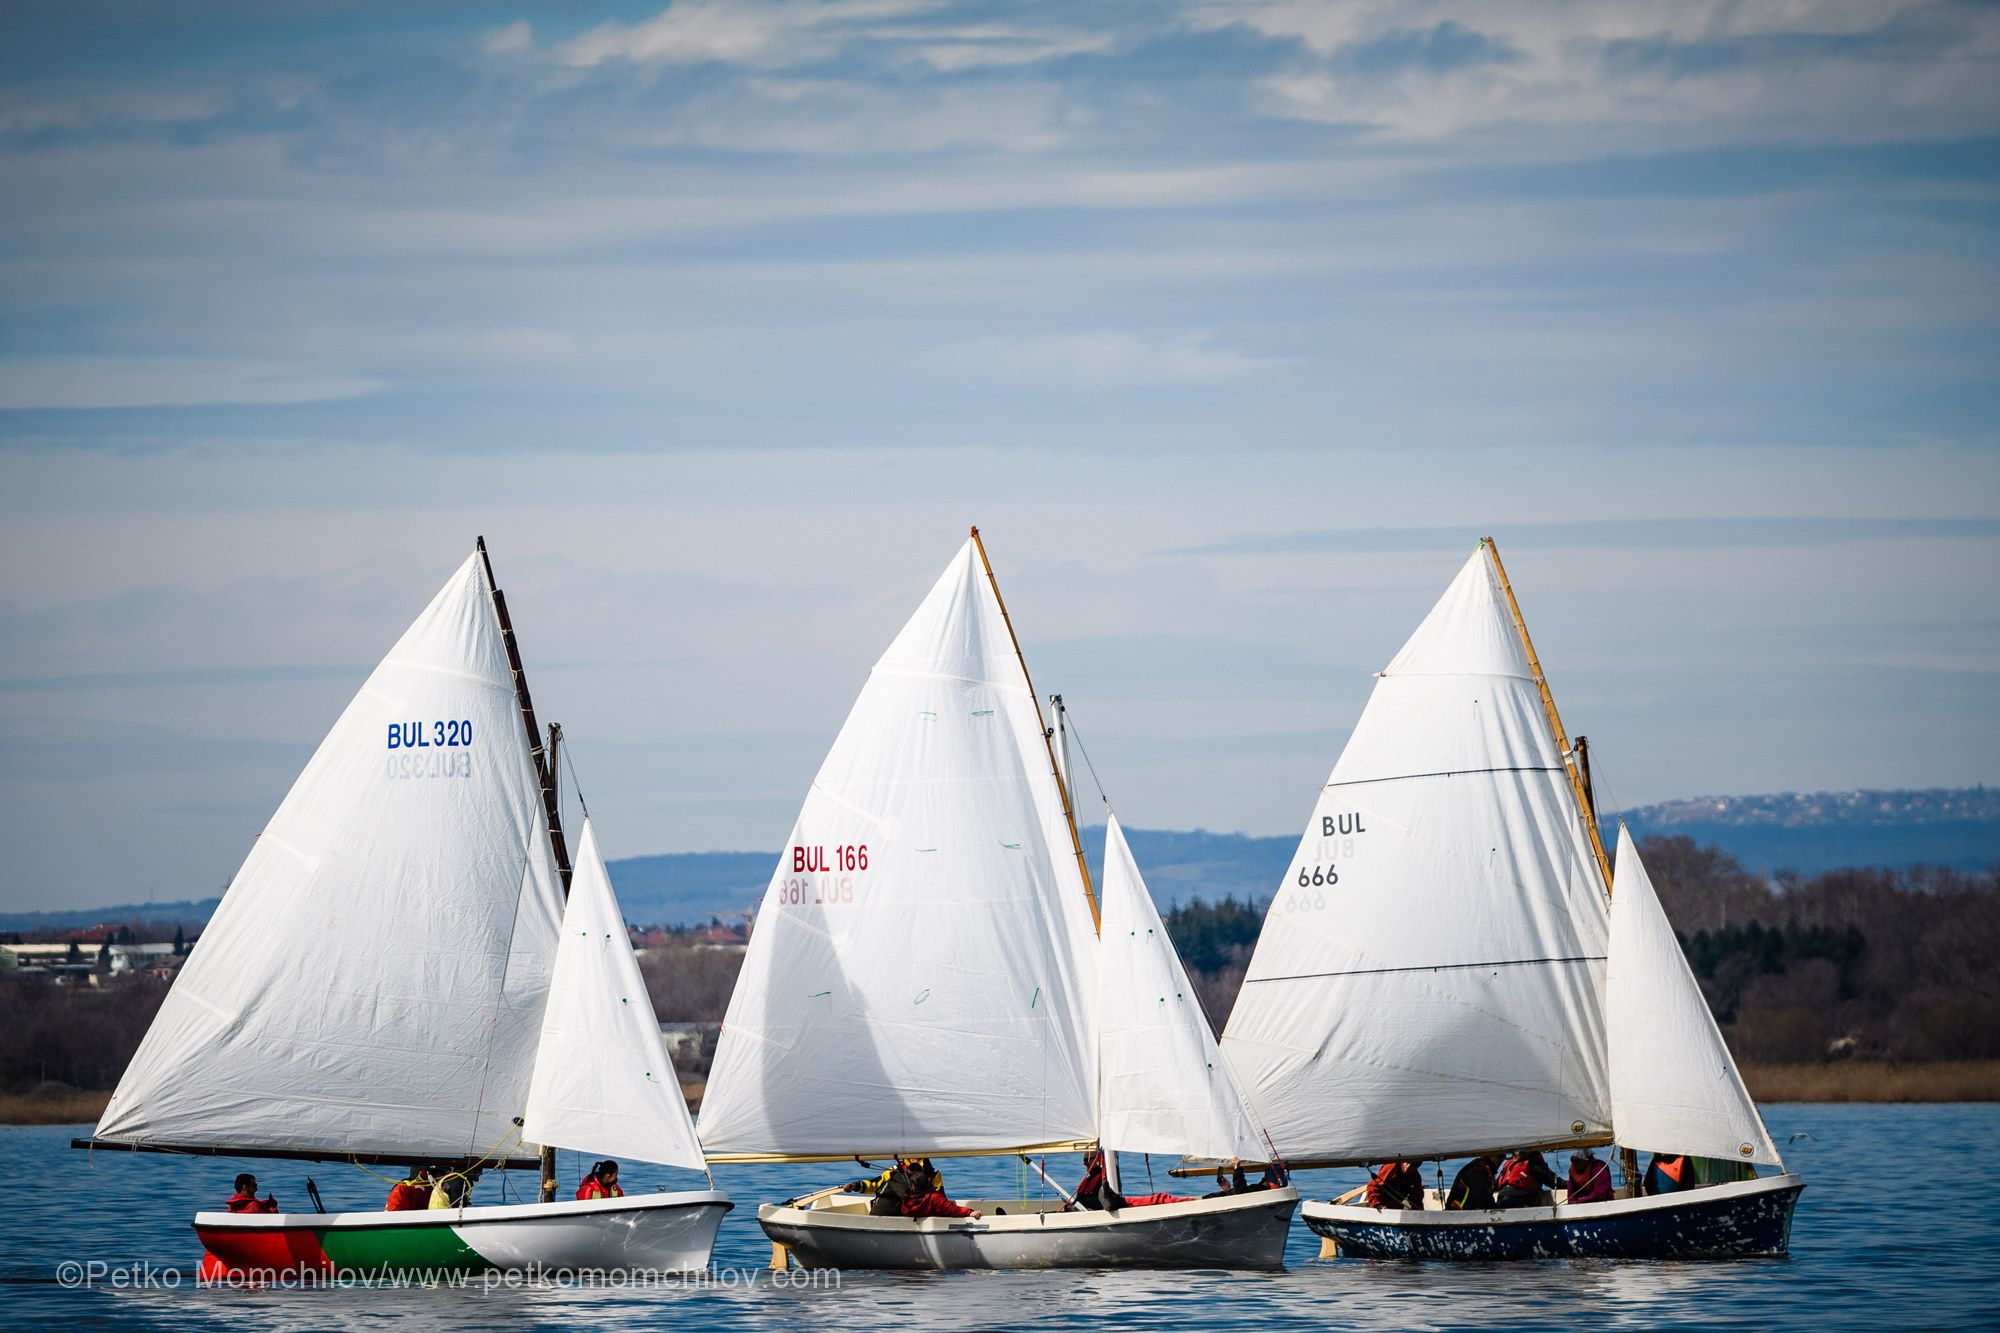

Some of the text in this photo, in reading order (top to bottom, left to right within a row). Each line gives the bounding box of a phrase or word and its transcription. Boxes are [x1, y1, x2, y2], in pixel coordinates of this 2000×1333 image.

[387, 720, 473, 749] BUL 320
[1322, 812, 1366, 837] BUL
[793, 844, 868, 872] BUL 166
[1298, 864, 1339, 888] 666
